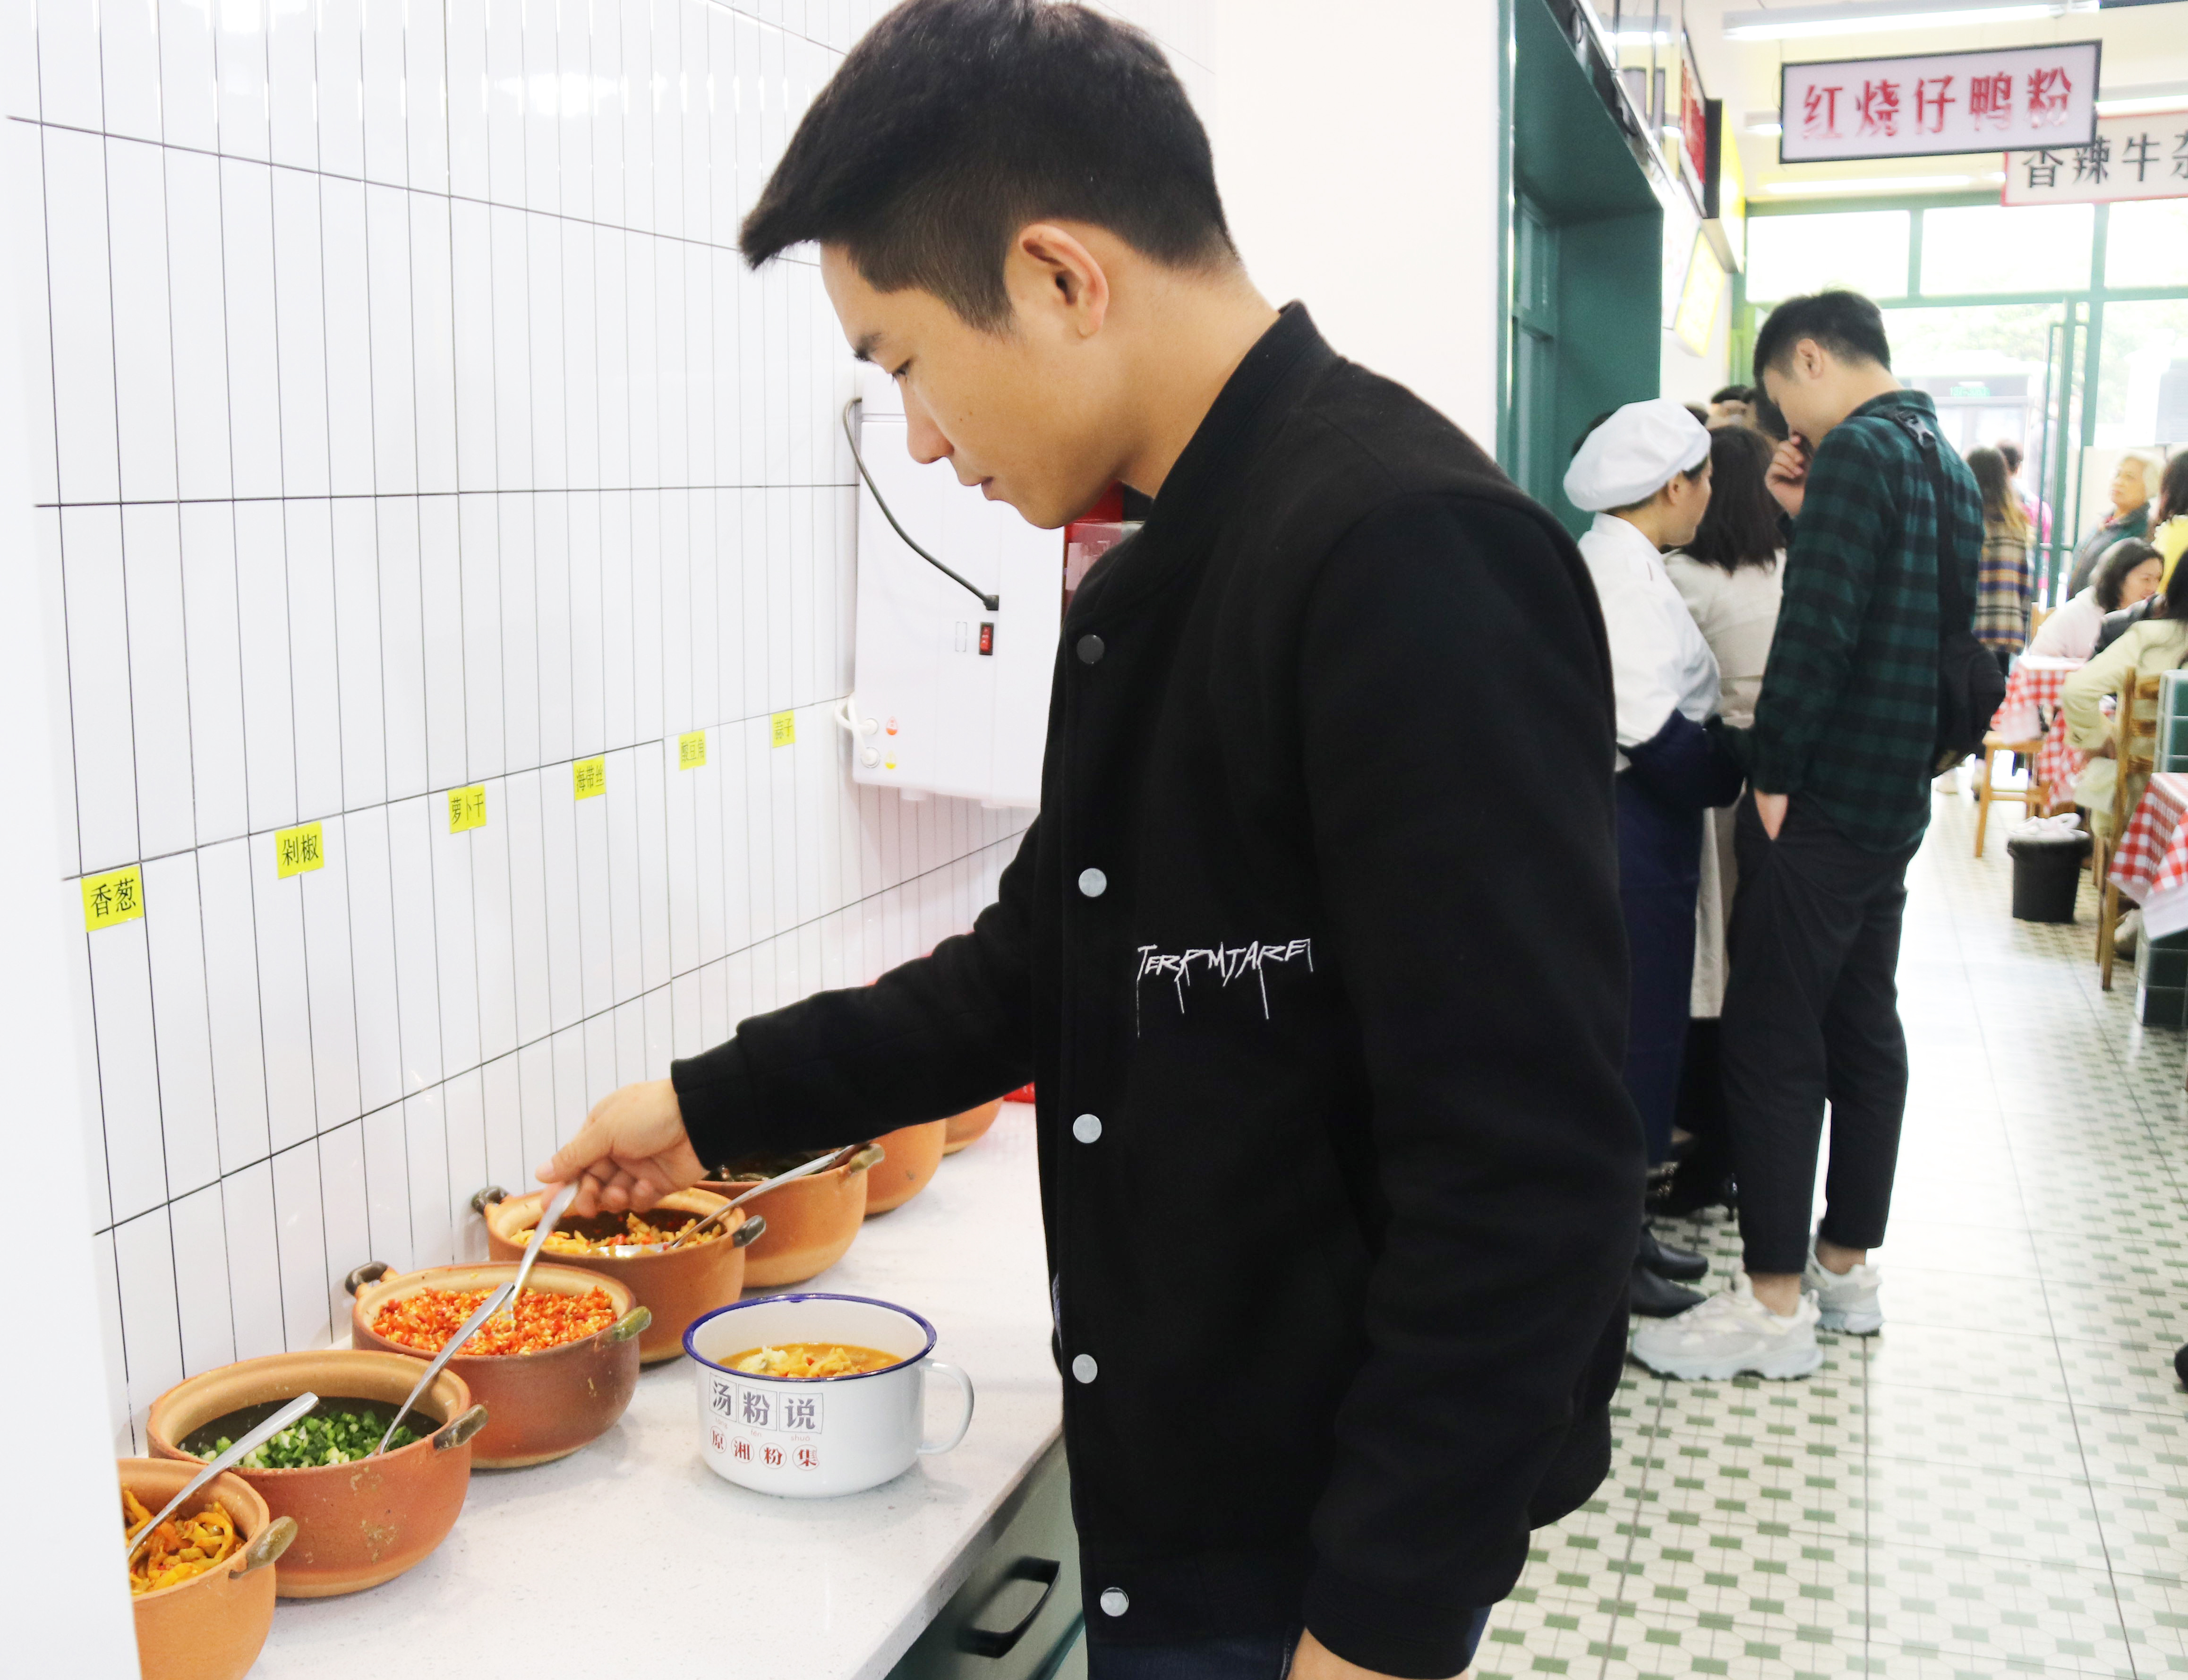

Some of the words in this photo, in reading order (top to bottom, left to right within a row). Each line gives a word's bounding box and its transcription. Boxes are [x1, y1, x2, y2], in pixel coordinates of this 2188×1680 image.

[1803, 67, 2072, 139] 红烧仔鸭粉
[773, 719, 792, 738] 蒜子
[451, 793, 484, 824] 萝卜干
[282, 833, 319, 866] 剁椒
[90, 877, 137, 917] 香葱
[713, 1380, 815, 1430] 汤粉说
[712, 1430, 818, 1466] 原湘粉集
